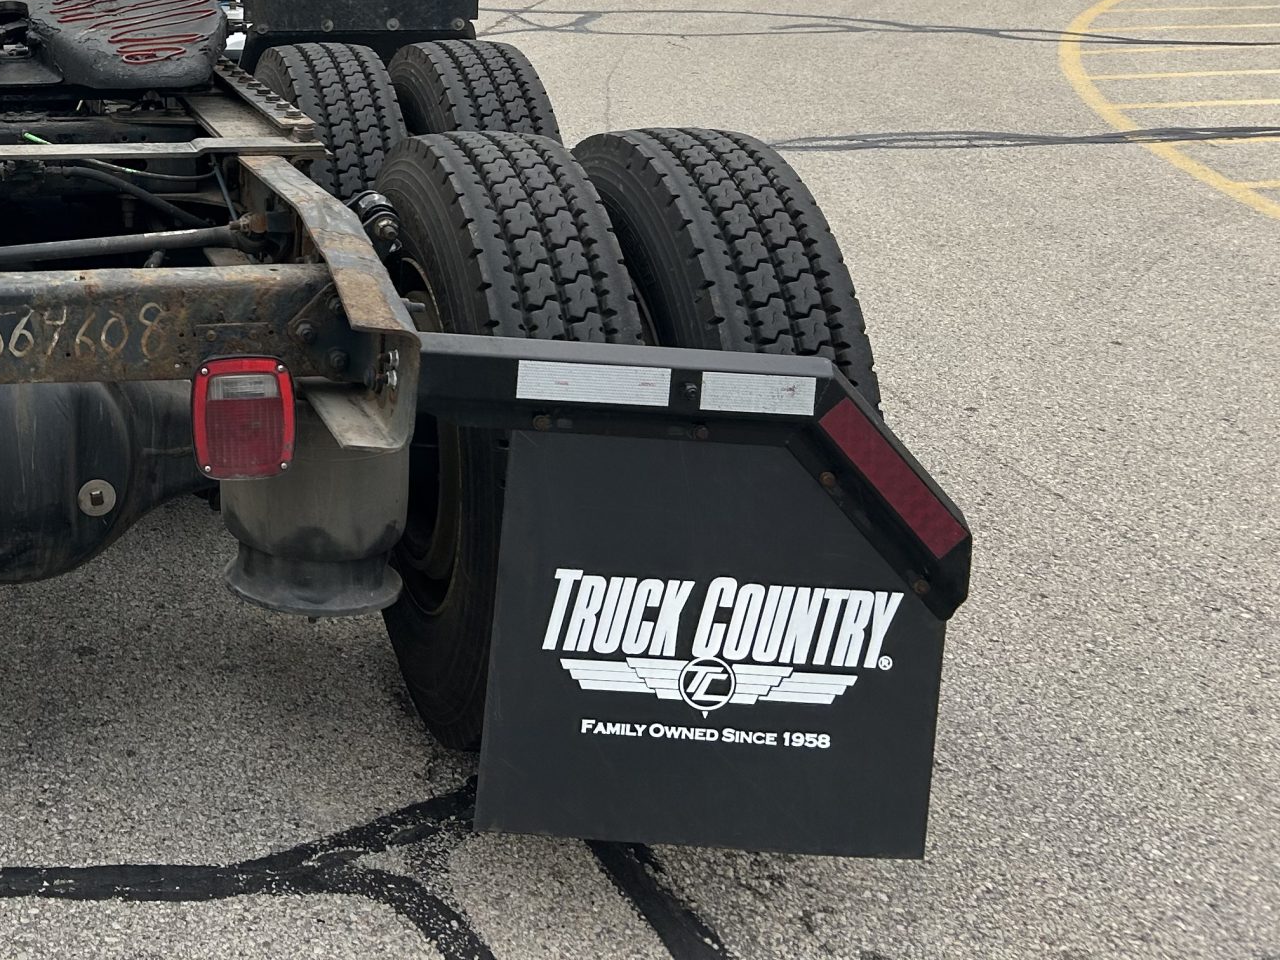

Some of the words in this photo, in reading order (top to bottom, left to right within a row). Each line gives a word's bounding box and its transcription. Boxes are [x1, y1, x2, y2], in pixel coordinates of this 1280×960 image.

[542, 568, 696, 657] TRUCK
[581, 719, 647, 737] FAMILY
[649, 723, 719, 742] OWNED
[721, 727, 777, 746] SINCE
[783, 731, 830, 749] 1958
